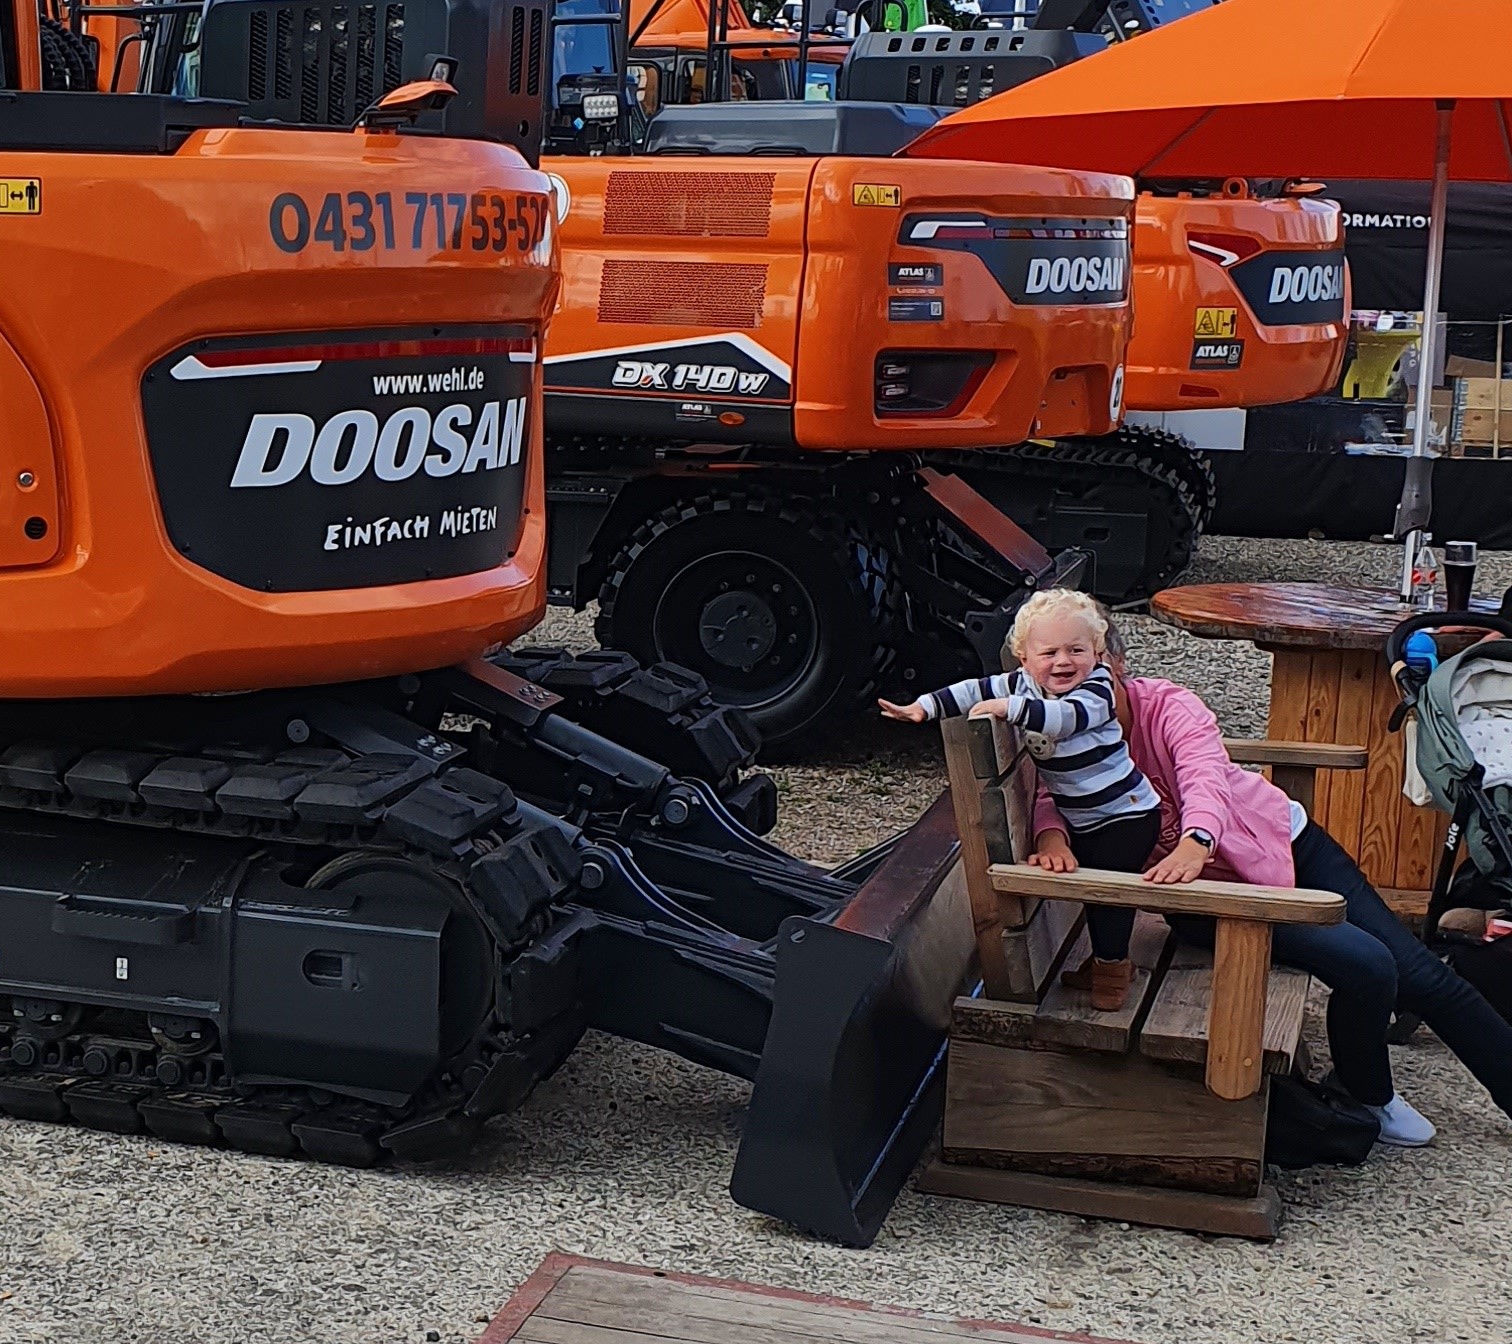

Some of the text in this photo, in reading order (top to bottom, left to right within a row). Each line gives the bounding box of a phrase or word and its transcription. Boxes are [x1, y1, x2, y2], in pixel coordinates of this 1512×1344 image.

[269, 191, 396, 253] 0431
[898, 267, 924, 276] ATLAS
[1025, 257, 1124, 294] DOOSAN
[1196, 344, 1229, 357] ATLAS
[373, 366, 485, 395] www.wehl.de
[229, 396, 527, 488] DOOSAN
[1445, 822, 1460, 851] Joie
